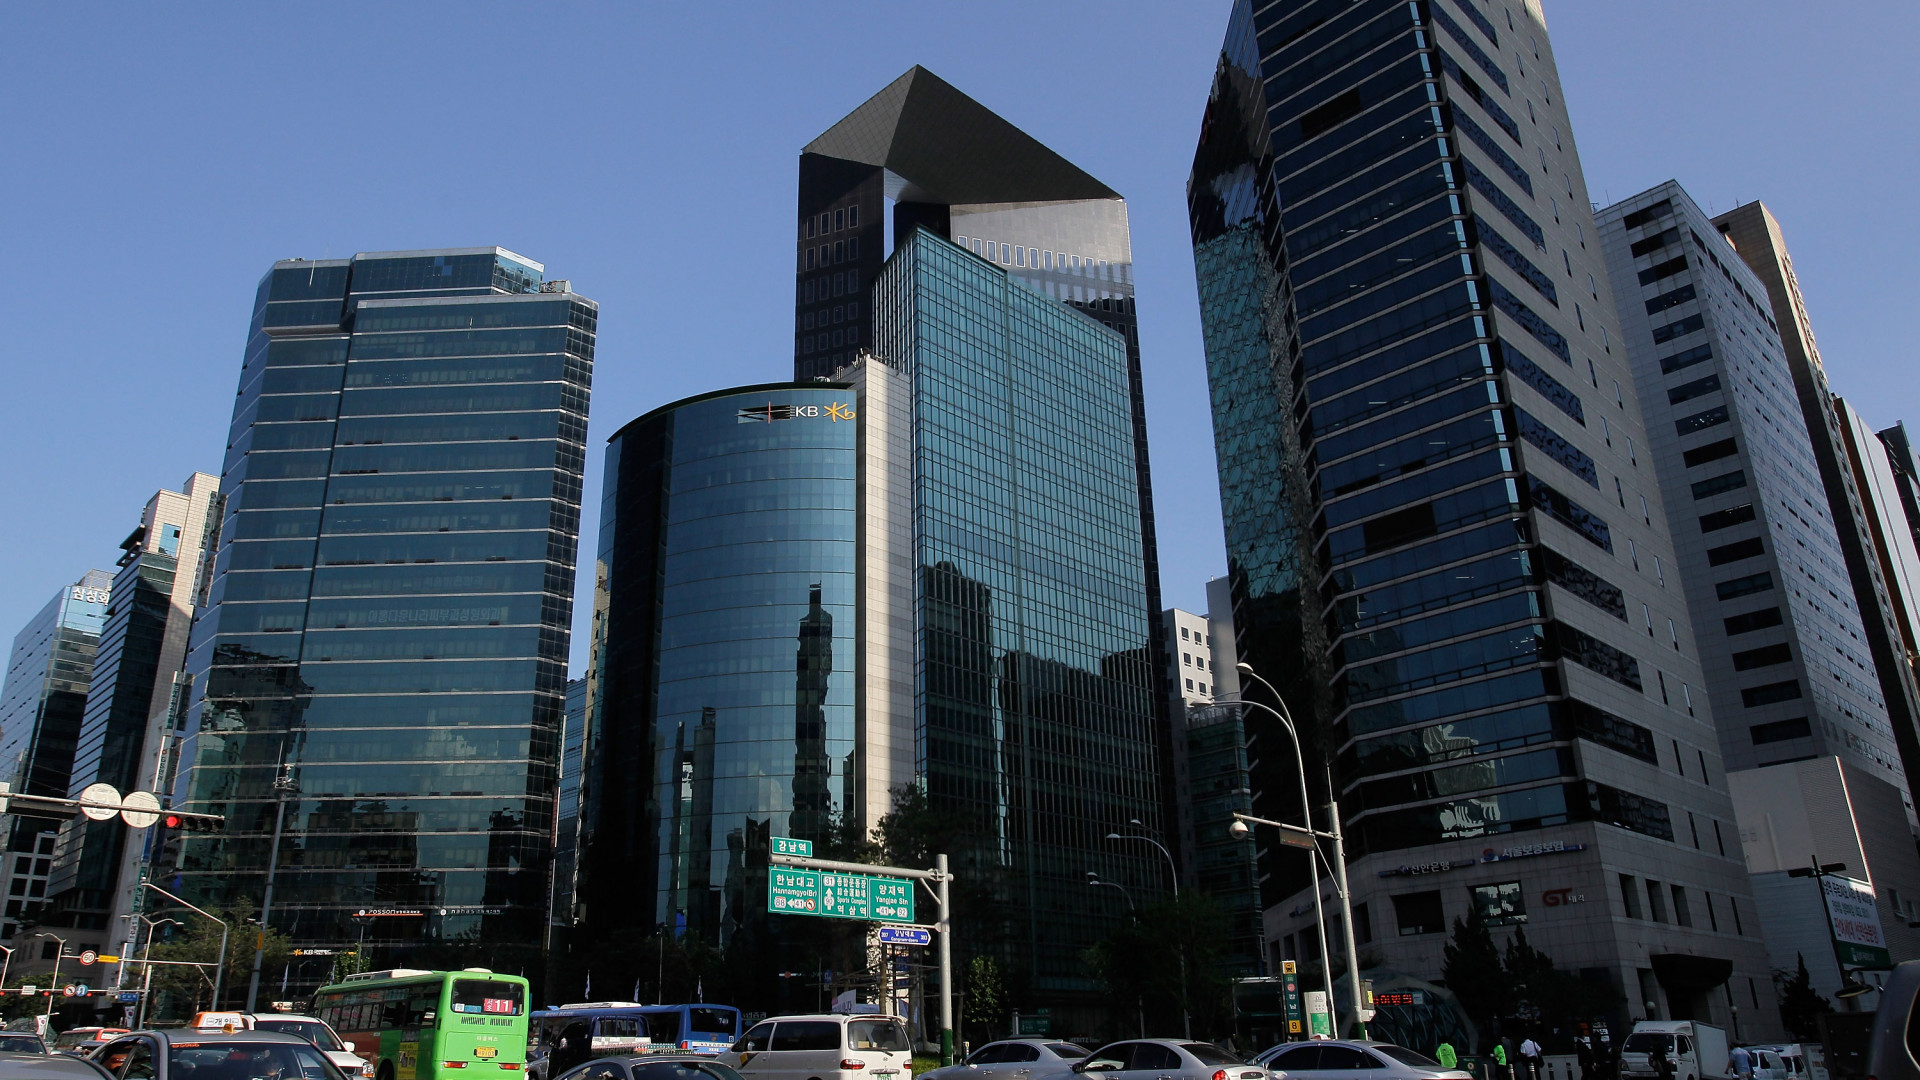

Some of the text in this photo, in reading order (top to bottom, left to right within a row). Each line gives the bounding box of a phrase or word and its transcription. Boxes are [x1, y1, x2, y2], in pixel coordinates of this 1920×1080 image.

[796, 406, 819, 417] KB
[778, 840, 807, 854] 강남역
[1502, 840, 1565, 858] 서울보증보험
[776, 874, 815, 888] 한남대교
[825, 877, 834, 886] 31
[837, 876, 867, 889] 종합운동장
[878, 884, 905, 897] 양재역
[775, 898, 804, 908] 88 41
[837, 896, 850, 904] Sports
[898, 897, 909, 906] Stn
[1542, 888, 1573, 907] GT
[837, 904, 867, 917] 역삼역
[880, 906, 907, 916] 41 92
[494, 999, 510, 1012] 11
[1291, 1021, 1298, 1030] 8
